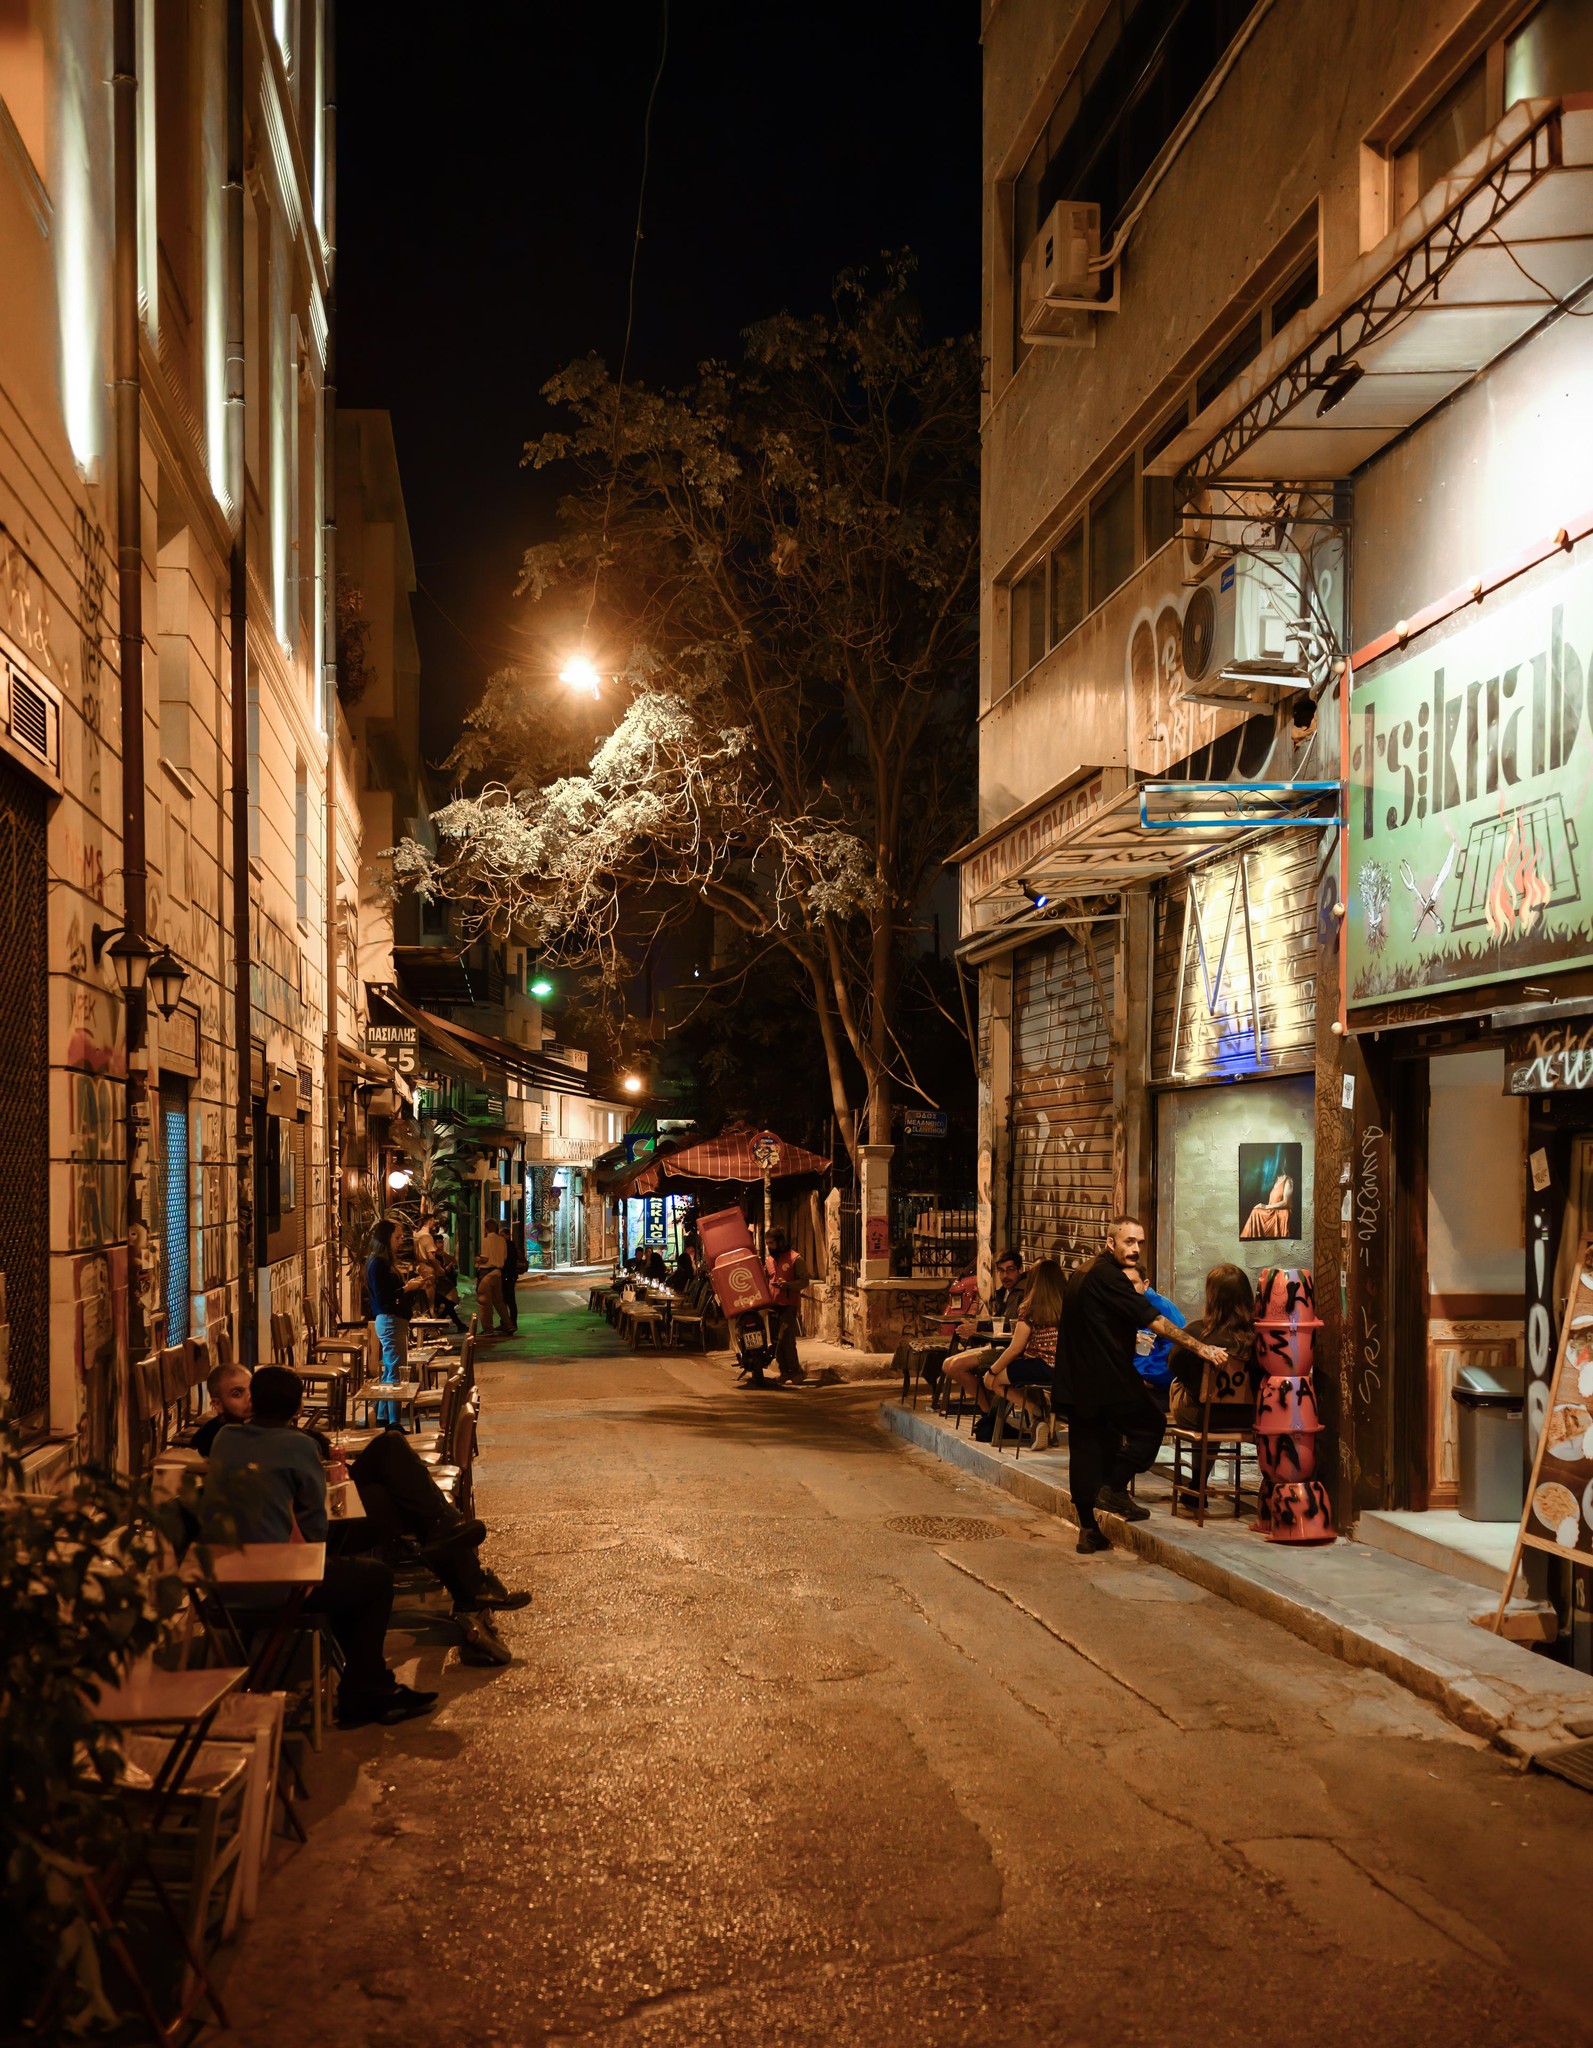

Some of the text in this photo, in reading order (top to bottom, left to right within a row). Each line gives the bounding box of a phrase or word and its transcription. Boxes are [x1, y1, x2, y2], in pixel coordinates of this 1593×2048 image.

[1352, 603, 1593, 841] tsiknab
[368, 1027, 416, 1042] ΠΑΣΙΑΛΗΣ
[370, 1047, 415, 1072] 3-5
[650, 1197, 663, 1238] ARKING
